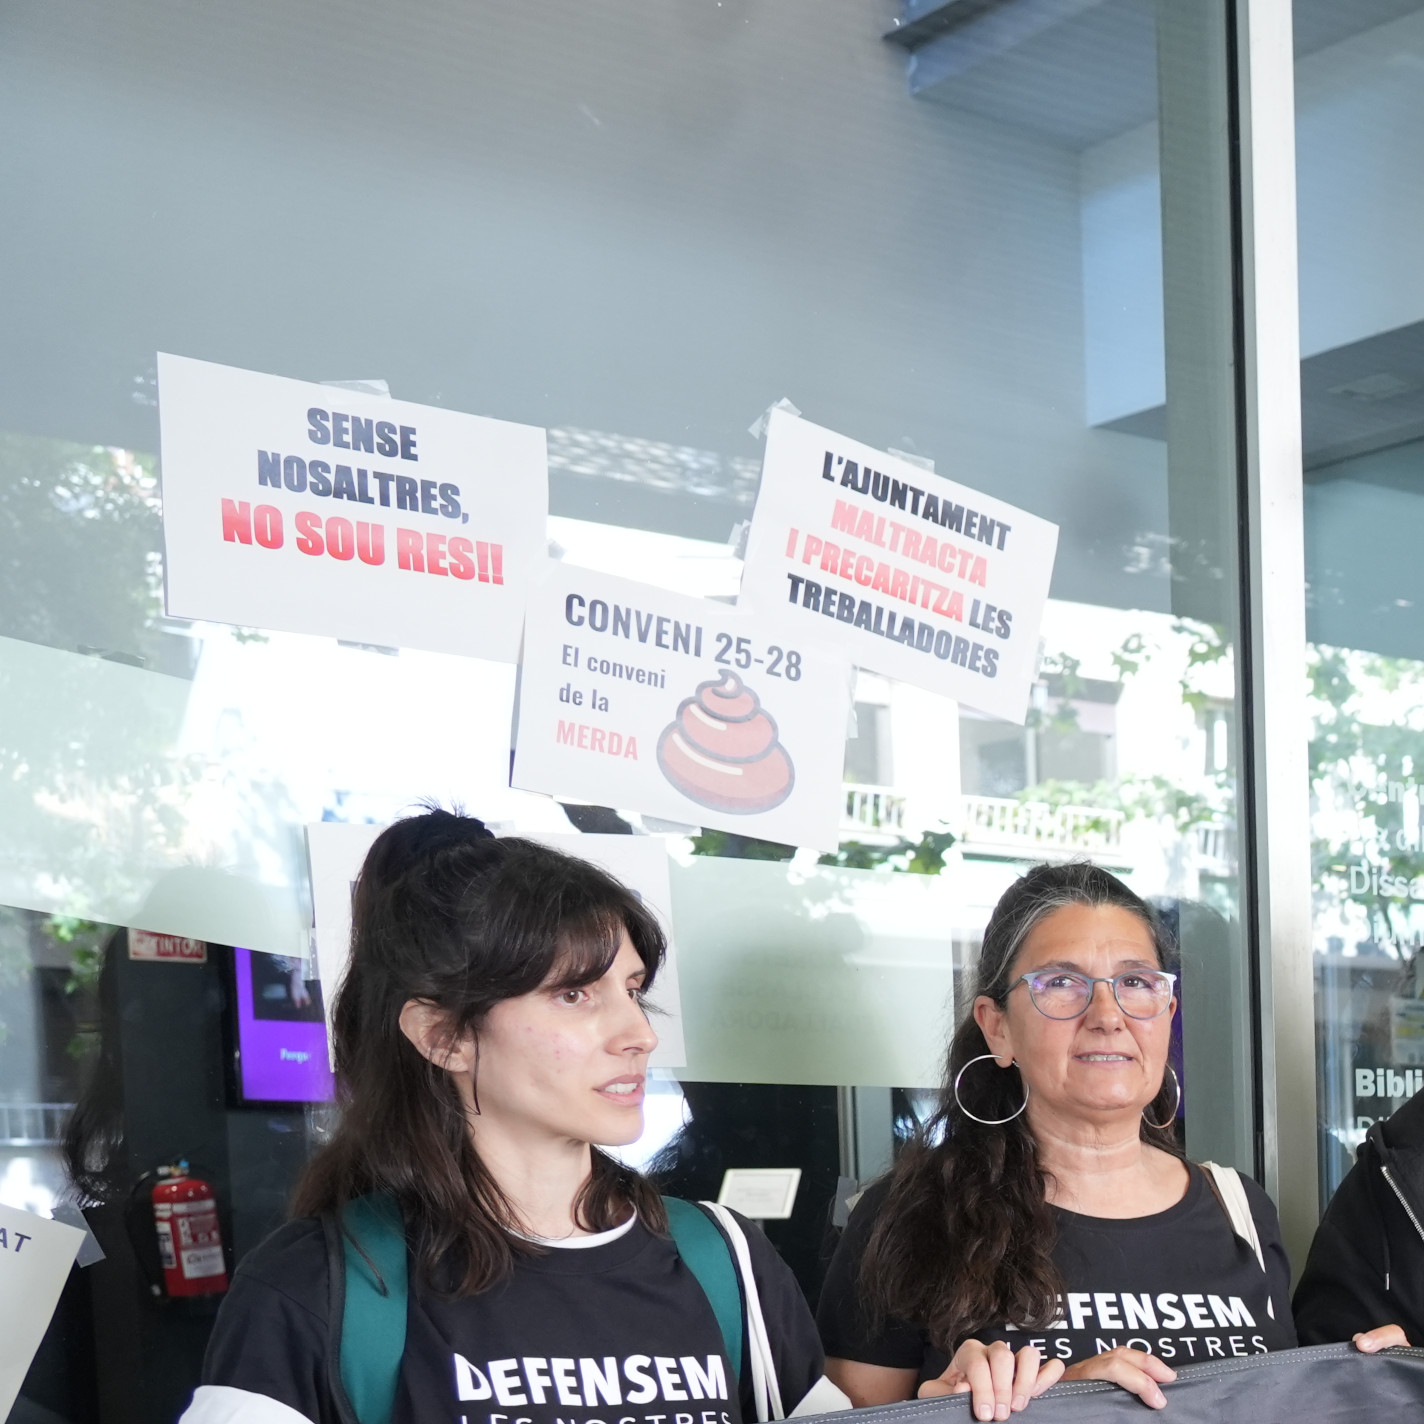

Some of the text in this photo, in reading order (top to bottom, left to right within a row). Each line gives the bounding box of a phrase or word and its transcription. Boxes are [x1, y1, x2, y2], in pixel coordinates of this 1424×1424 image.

[307, 407, 419, 462] SENSE
[256, 449, 470, 525] NOSALTRES,
[822, 450, 1012, 552] L'AJUNTAMENT
[221, 497, 505, 586] NO SOU RES!!
[831, 498, 988, 589] MALTRACTA
[785, 527, 1013, 641] I PRECARITZA LES
[562, 643, 667, 690] El conveni
[564, 592, 803, 683] CONVENI 25-28
[787, 572, 1000, 679] TREBALLADORES
[558, 682, 610, 713] de la
[555, 719, 639, 763] MERDA
[453, 1352, 729, 1407] DEFENSEM
